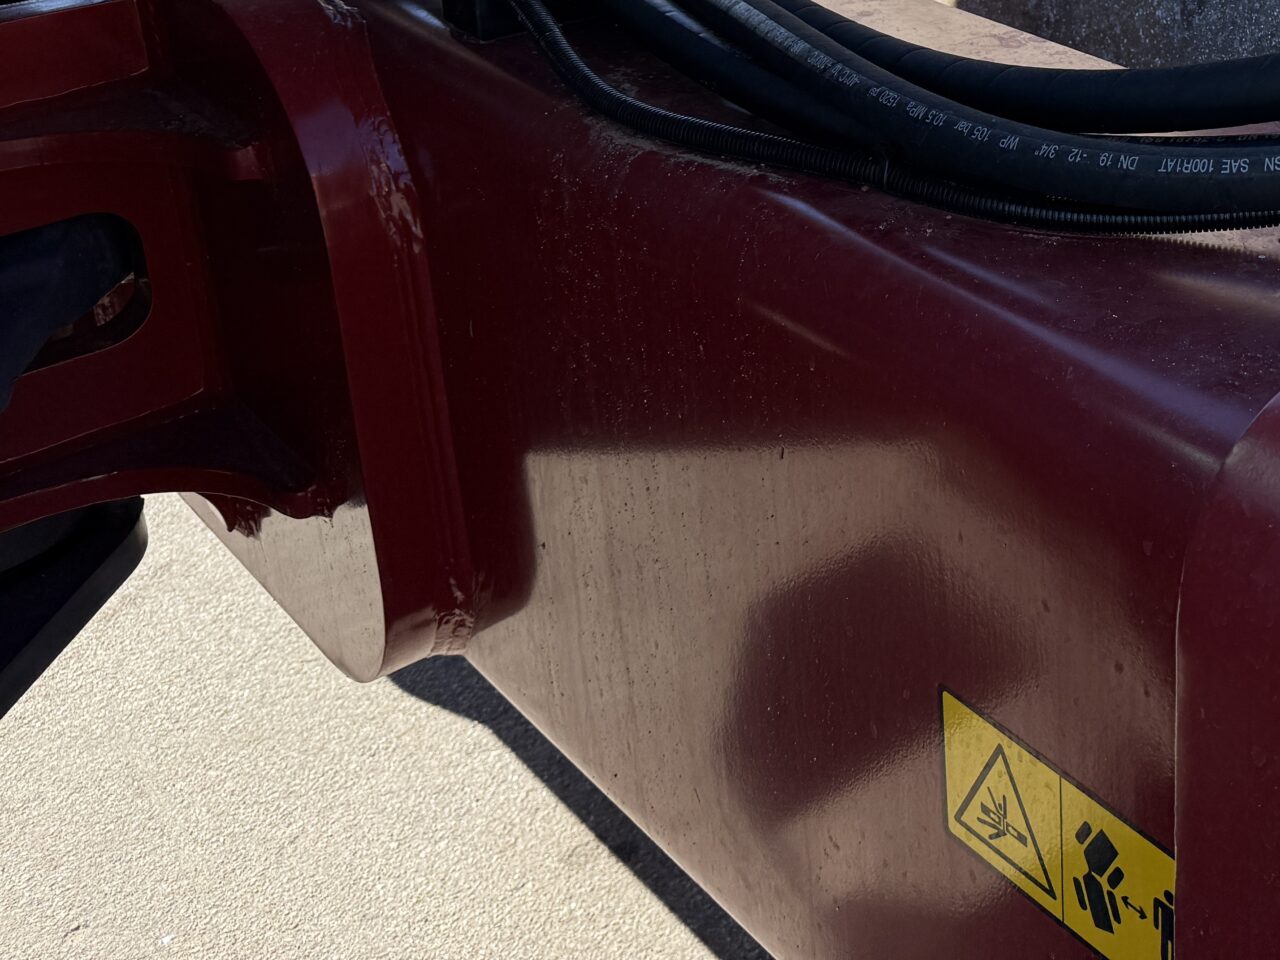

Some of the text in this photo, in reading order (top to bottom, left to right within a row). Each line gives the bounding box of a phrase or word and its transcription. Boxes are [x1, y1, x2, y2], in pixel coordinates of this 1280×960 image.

[906, 101, 928, 120] MPa
[926, 109, 948, 127] 10.5
[953, 121, 972, 136] bar
[974, 126, 992, 142] 105
[999, 135, 1020, 150] WP
[1068, 148, 1088, 163] -12
[1099, 152, 1113, 167] 19
[1118, 155, 1139, 170] DN
[1158, 158, 1214, 173] 100R1AT
[1221, 158, 1250, 174] SAE
